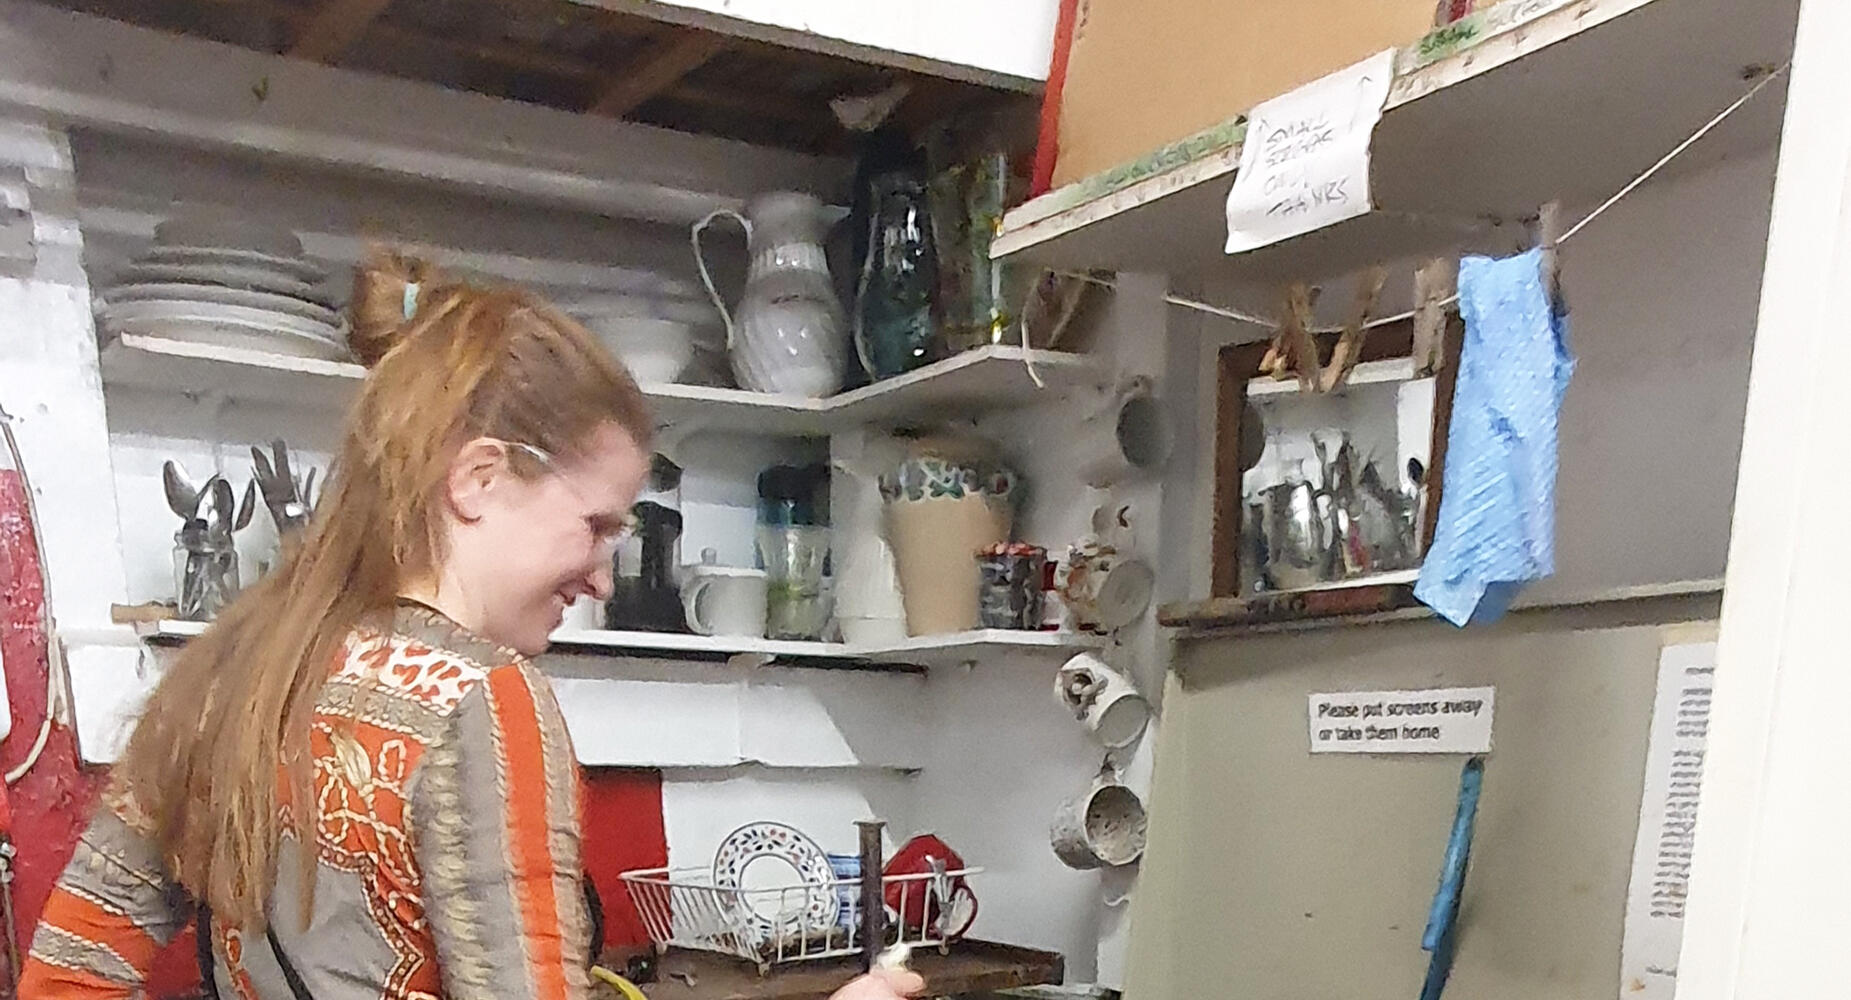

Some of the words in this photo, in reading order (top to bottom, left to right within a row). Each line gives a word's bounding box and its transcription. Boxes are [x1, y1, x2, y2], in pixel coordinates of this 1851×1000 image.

[1318, 703, 1359, 718] Please
[1363, 702, 1383, 720] put
[1387, 701, 1438, 716] screens
[1441, 699, 1483, 717] away
[1319, 728, 1332, 740] or
[1336, 726, 1362, 740] take
[1365, 725, 1398, 739] them
[1402, 724, 1440, 740] home
